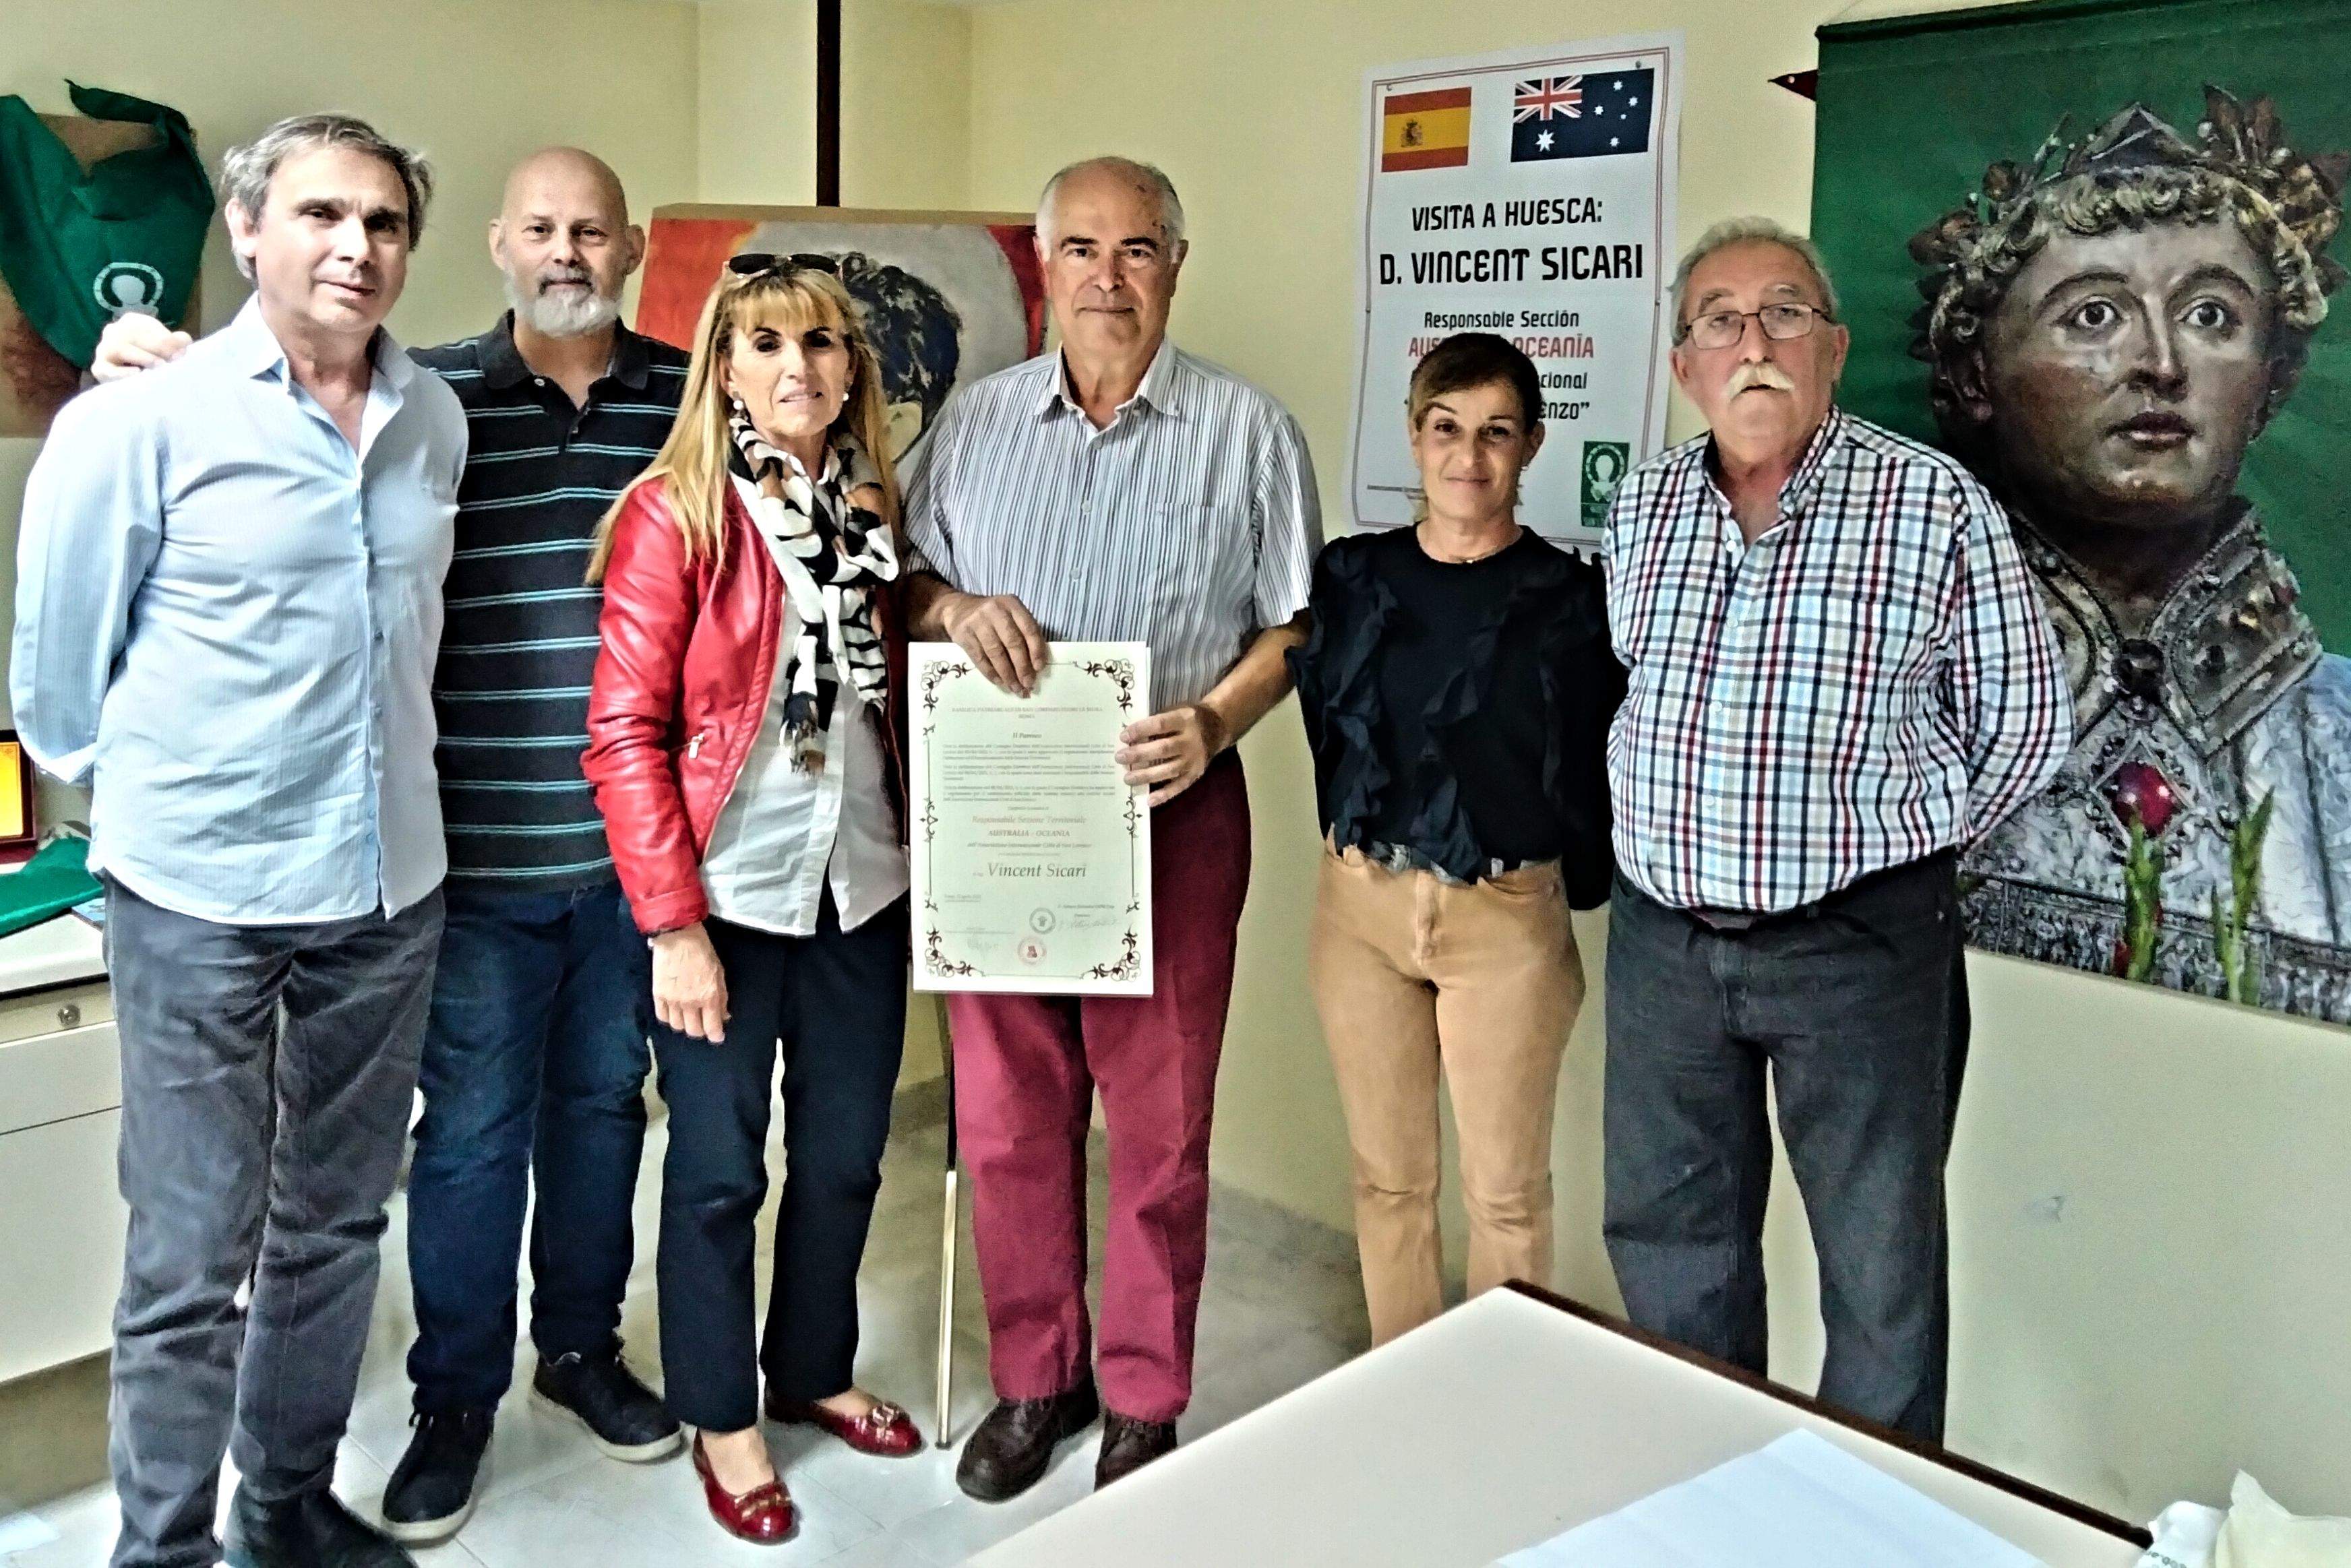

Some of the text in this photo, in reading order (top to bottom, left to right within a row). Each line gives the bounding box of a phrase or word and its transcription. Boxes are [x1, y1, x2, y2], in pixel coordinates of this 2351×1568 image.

[1412, 197, 1603, 231] VISITA A HUESCA:
[1380, 243, 1643, 285] D. VINCENT SICARI
[1424, 309, 1579, 331] Responsable Sección
[987, 862, 1087, 877] Vincent Sicari
